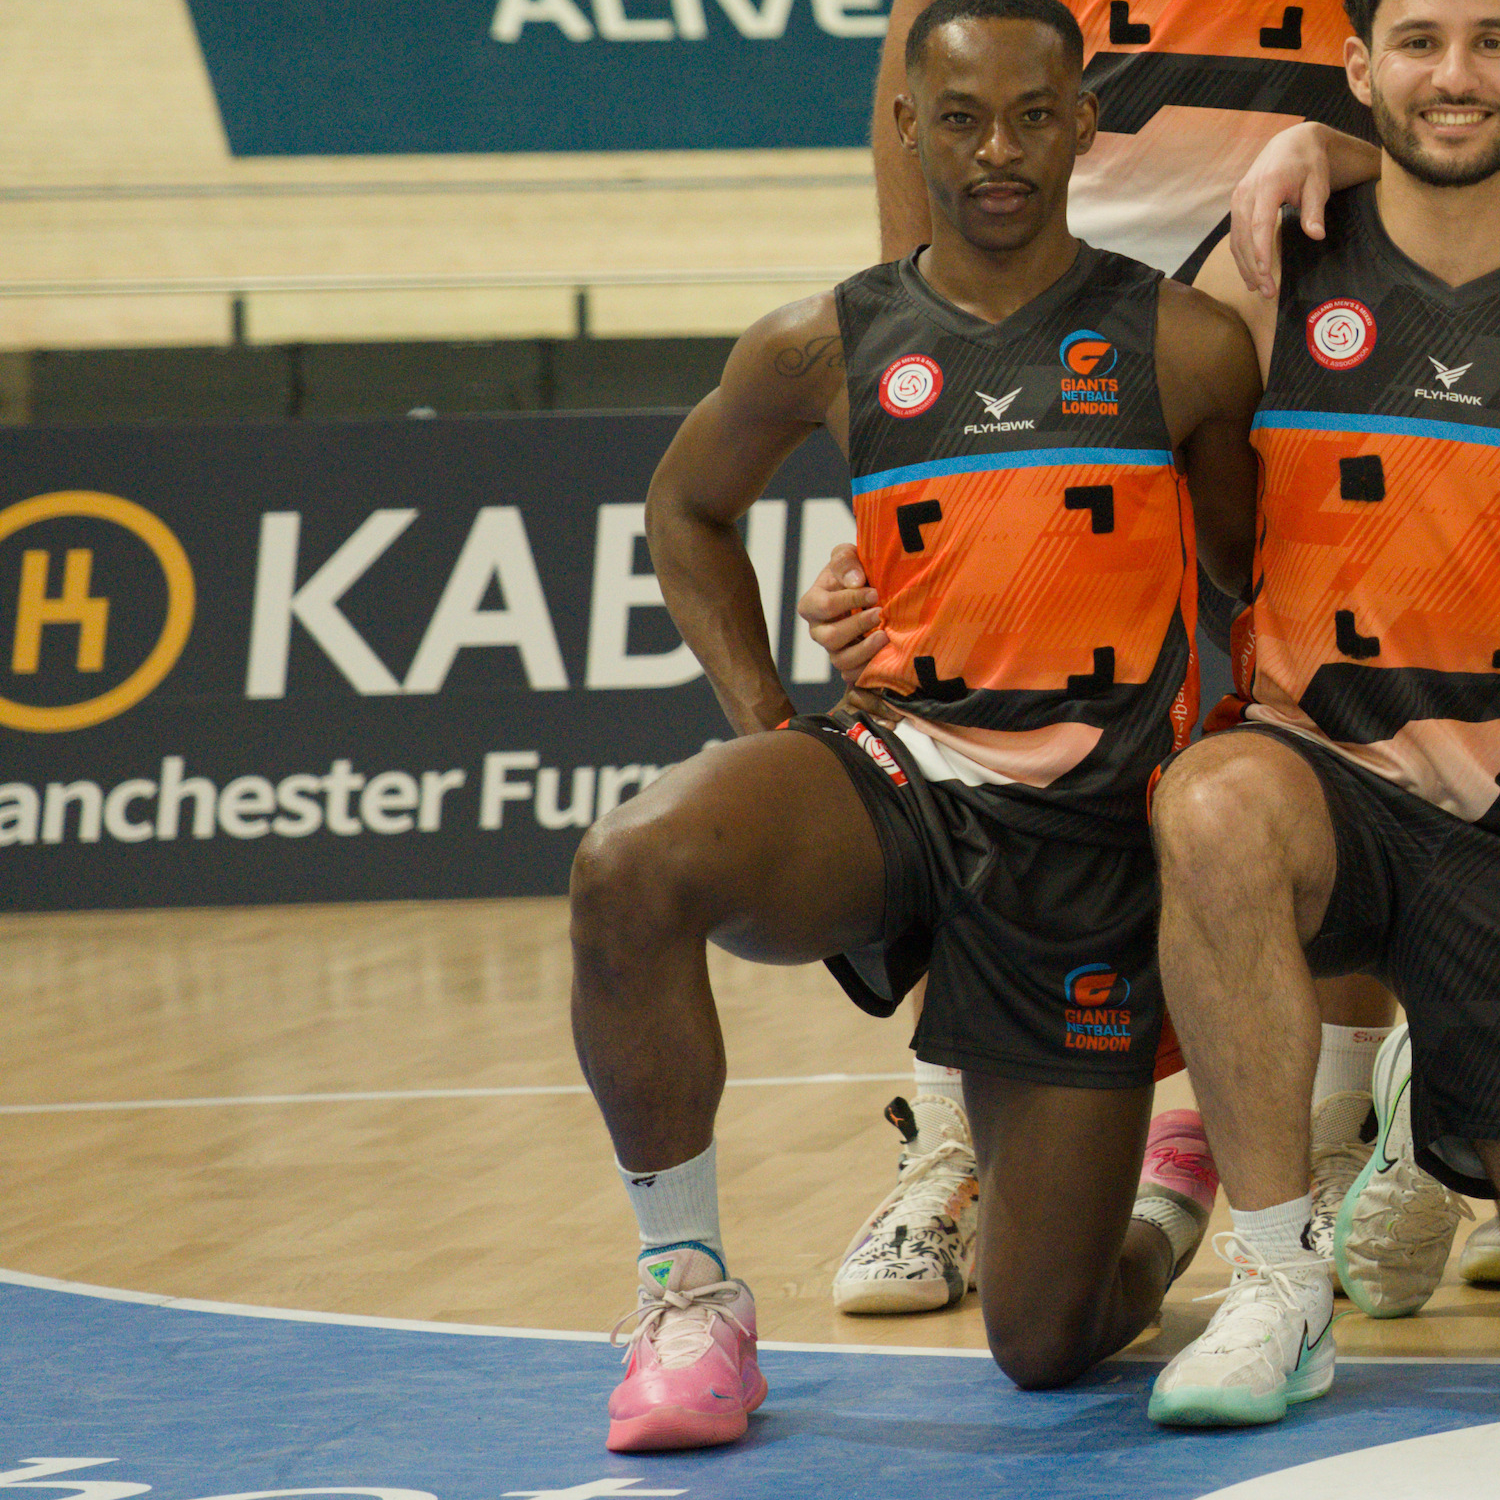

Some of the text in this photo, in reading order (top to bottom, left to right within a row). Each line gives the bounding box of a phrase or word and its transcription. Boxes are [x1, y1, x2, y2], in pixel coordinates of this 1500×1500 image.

[1061, 378, 1118, 391] GIANTS
[1061, 390, 1118, 402] NETBALL
[1062, 400, 1117, 415] LONDON
[1065, 1010, 1131, 1025] GIANTS
[1066, 1022, 1131, 1037] NETBALL
[1065, 1033, 1131, 1050] LONDON
